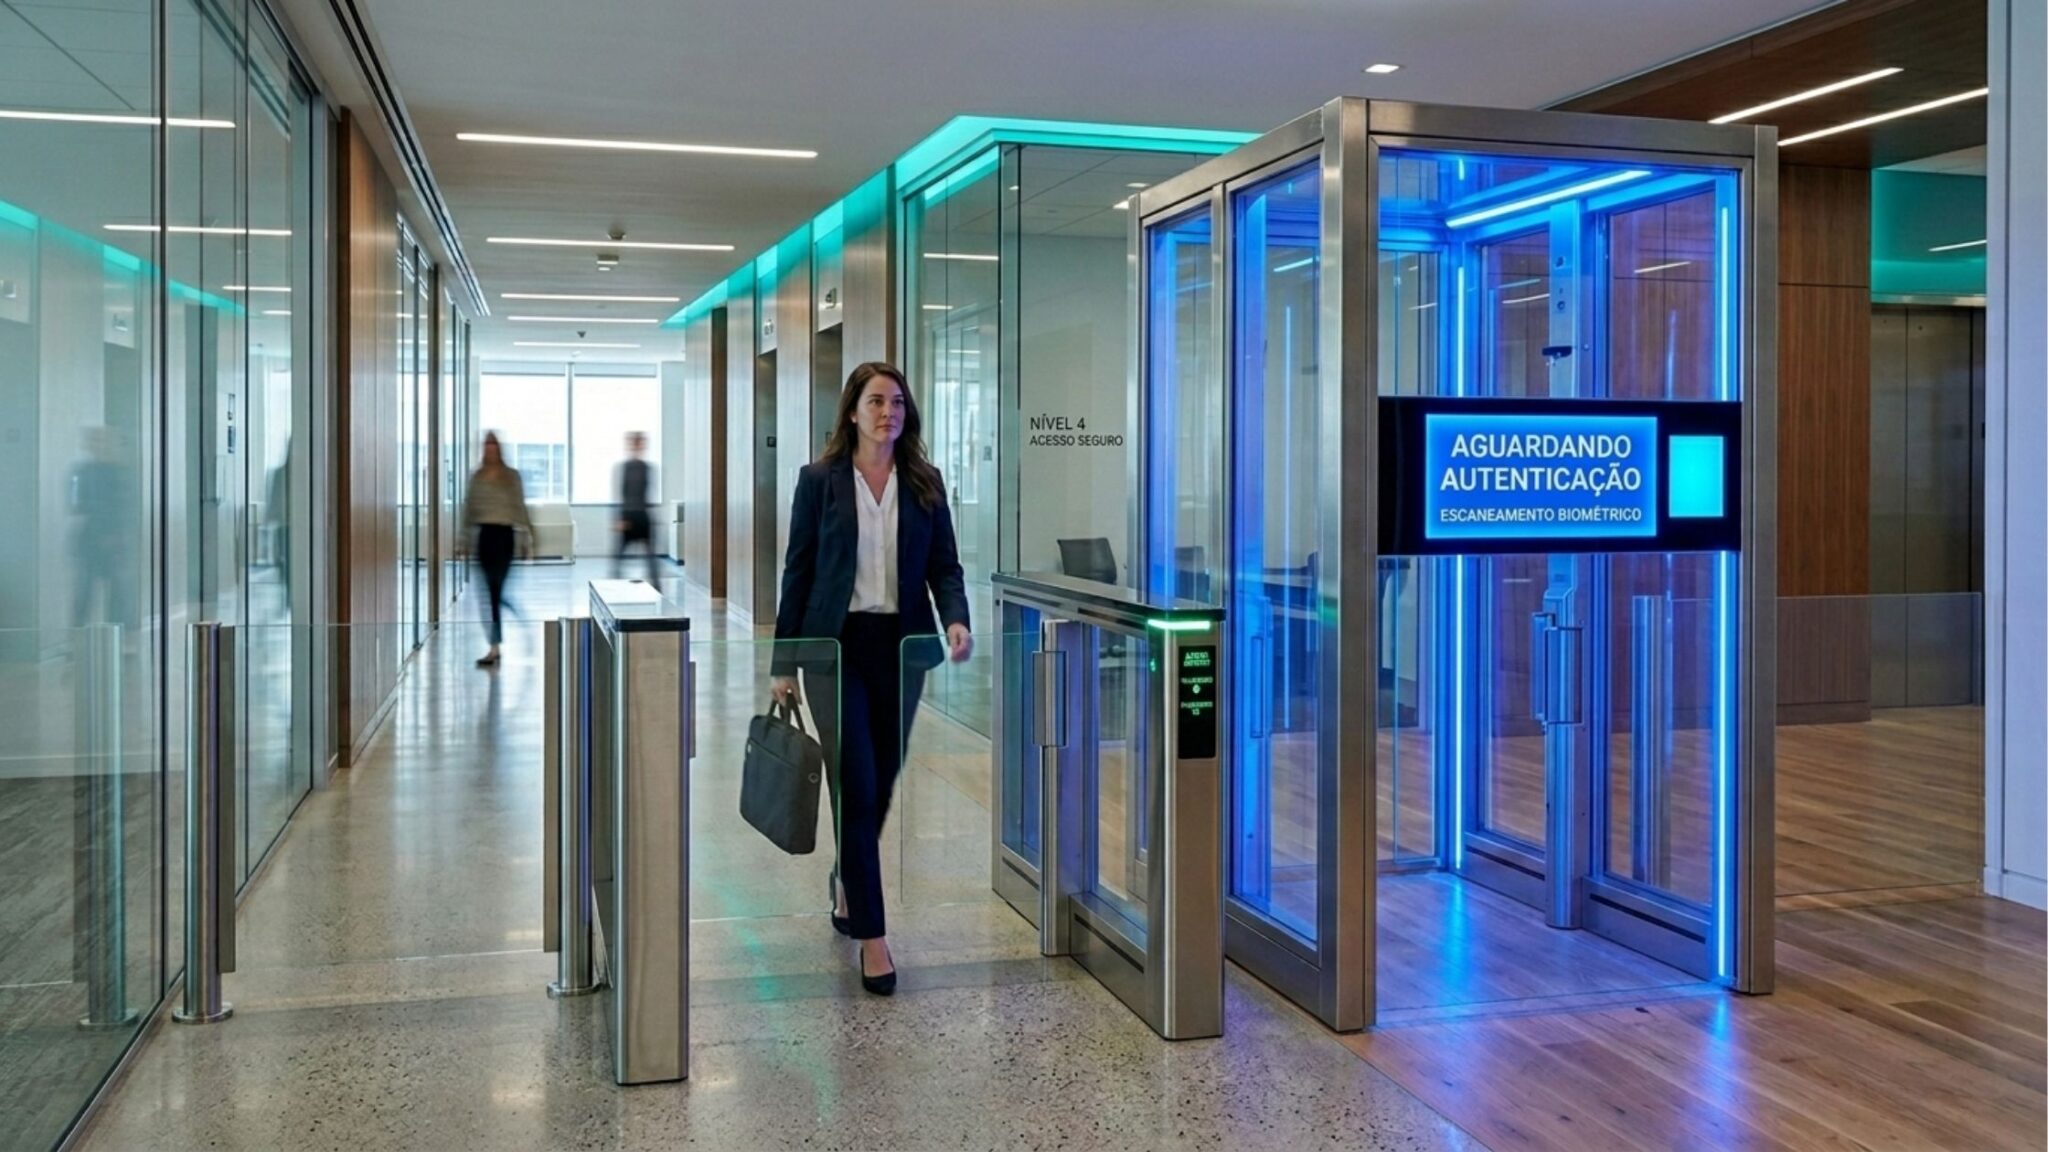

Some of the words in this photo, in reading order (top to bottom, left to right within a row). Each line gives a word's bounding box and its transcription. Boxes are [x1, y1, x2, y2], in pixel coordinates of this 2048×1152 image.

[1030, 413, 1073, 430] NÍVEL
[1077, 417, 1086, 430] 4
[1029, 434, 1075, 446] ACESSO
[1077, 434, 1124, 446] SEGURO
[1451, 434, 1632, 458] AGUARDANDO
[1440, 463, 1642, 496] AUTENTICAÇÃO
[1440, 508, 1555, 522] ESCANEAMENTO
[1558, 505, 1642, 522] BIOMÉTRICO
